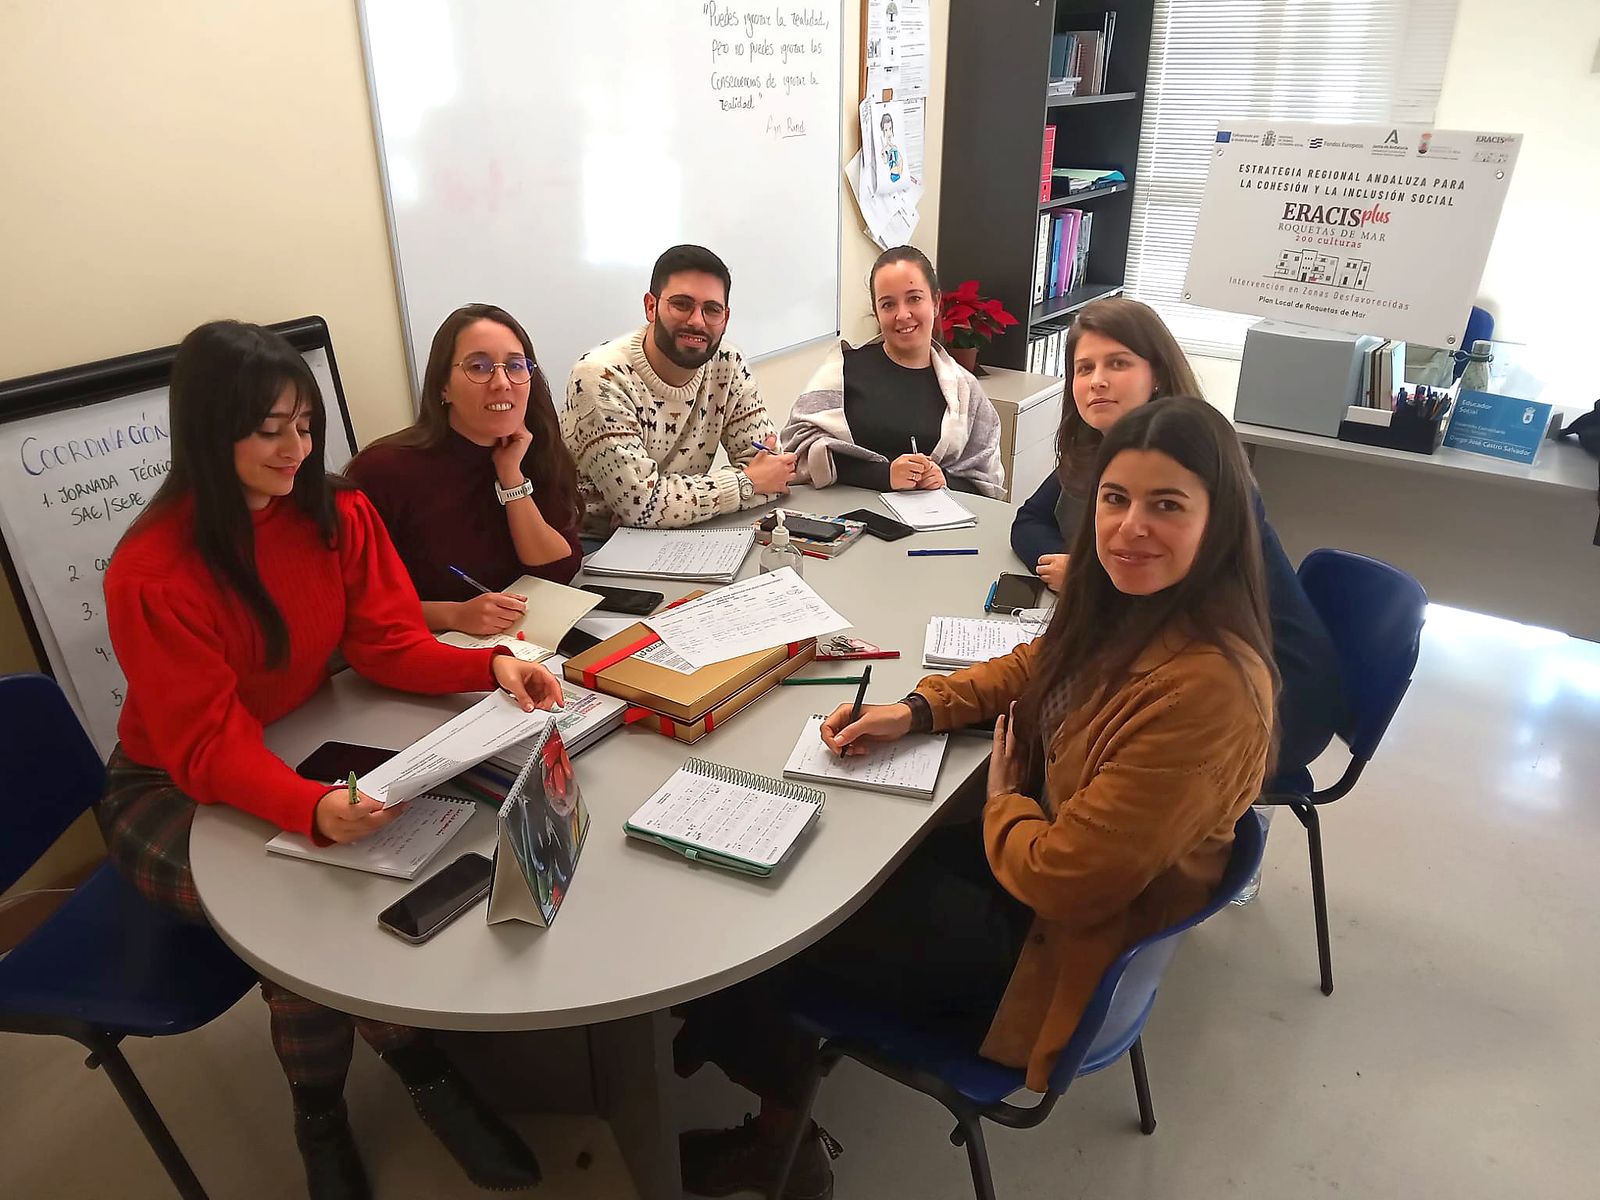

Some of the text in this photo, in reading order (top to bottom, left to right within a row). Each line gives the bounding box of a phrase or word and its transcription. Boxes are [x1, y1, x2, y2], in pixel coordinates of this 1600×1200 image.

[735, 43, 745, 56] no
[766, 73, 777, 89] de
[1239, 164, 1465, 190] ESTRATEGIA REGIONAL ANDALUZA PARA
[1240, 179, 1454, 206] LA COHESIÓN Y LA INCLUSIÓN SOCIAL
[1278, 222, 1386, 242] ROQUETAS DE MAR
[1295, 235, 1363, 249] 200 culturas
[1229, 276, 1410, 311] Intervención en Zonas Desfavorecidas
[1258, 295, 1367, 319] Plan Local de Roquetas de Mar
[58, 474, 119, 503] JORNADA
